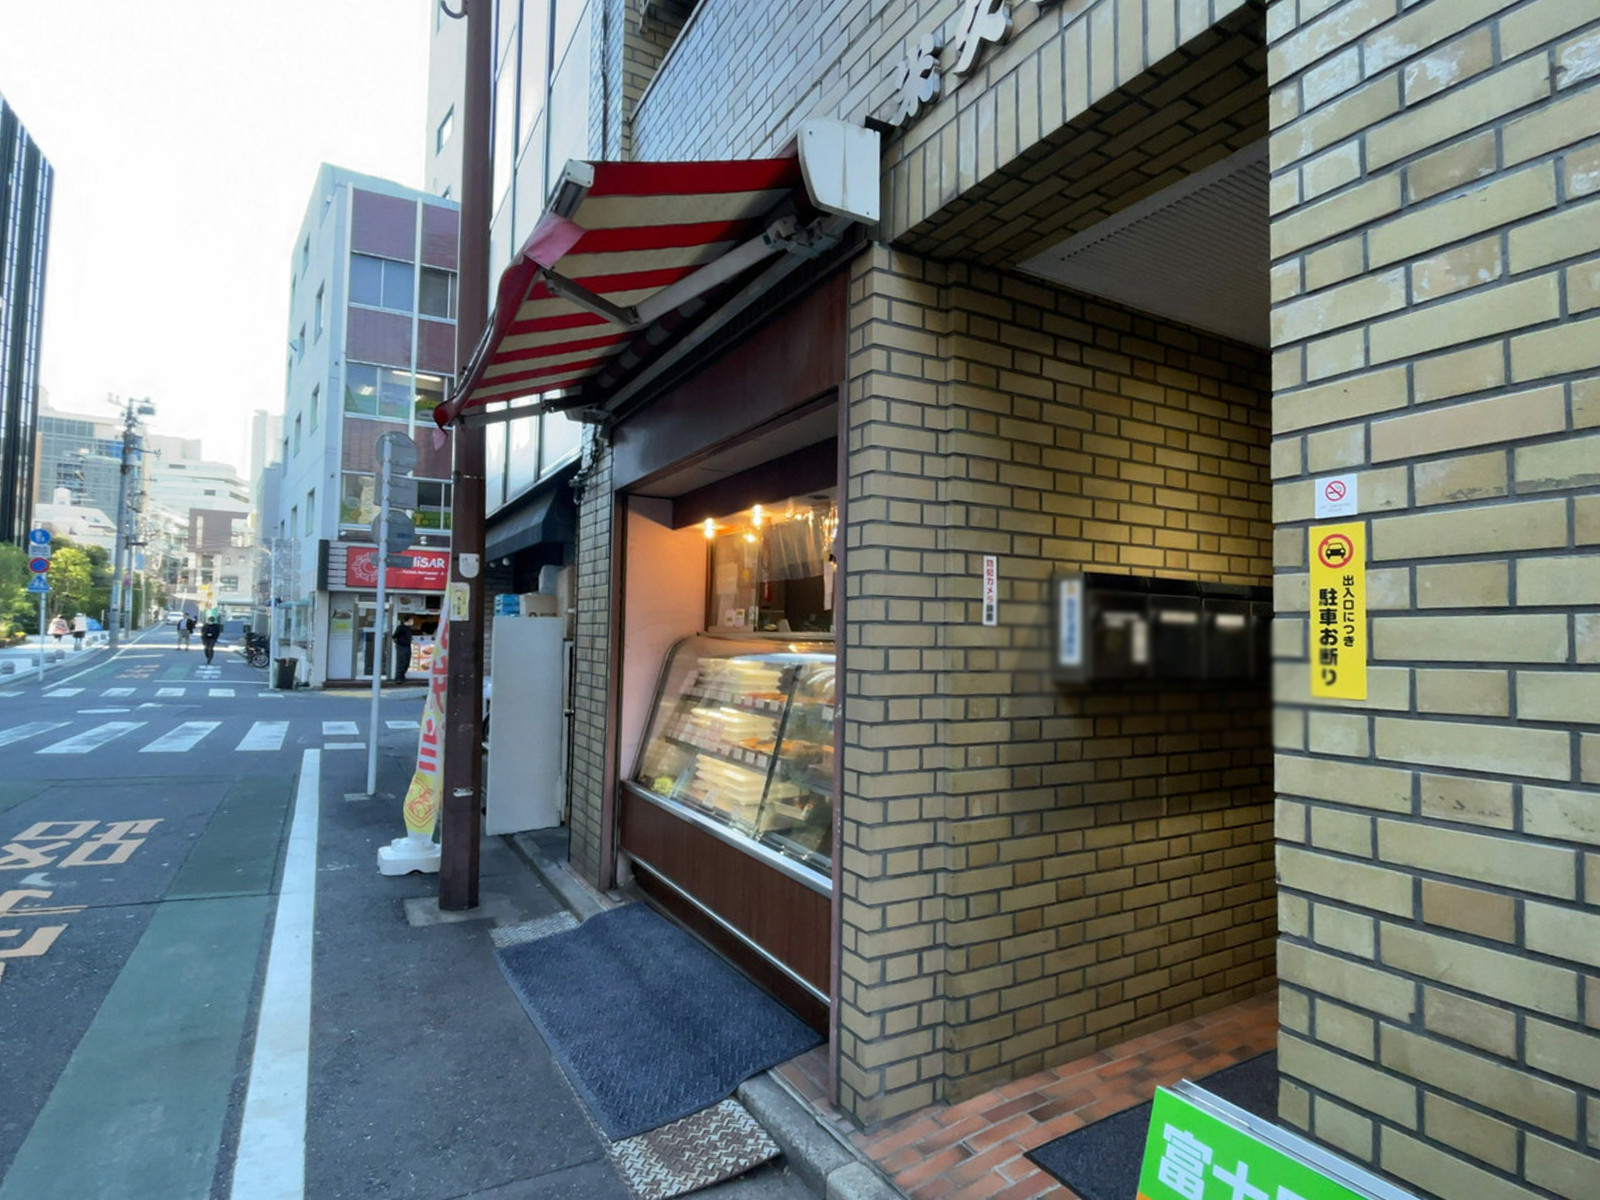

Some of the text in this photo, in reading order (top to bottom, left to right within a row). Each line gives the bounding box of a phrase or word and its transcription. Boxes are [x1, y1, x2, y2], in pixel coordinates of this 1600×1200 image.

[1319, 588, 1338, 686] 駐車お断り
[1342, 575, 1355, 647] 出入口につき
